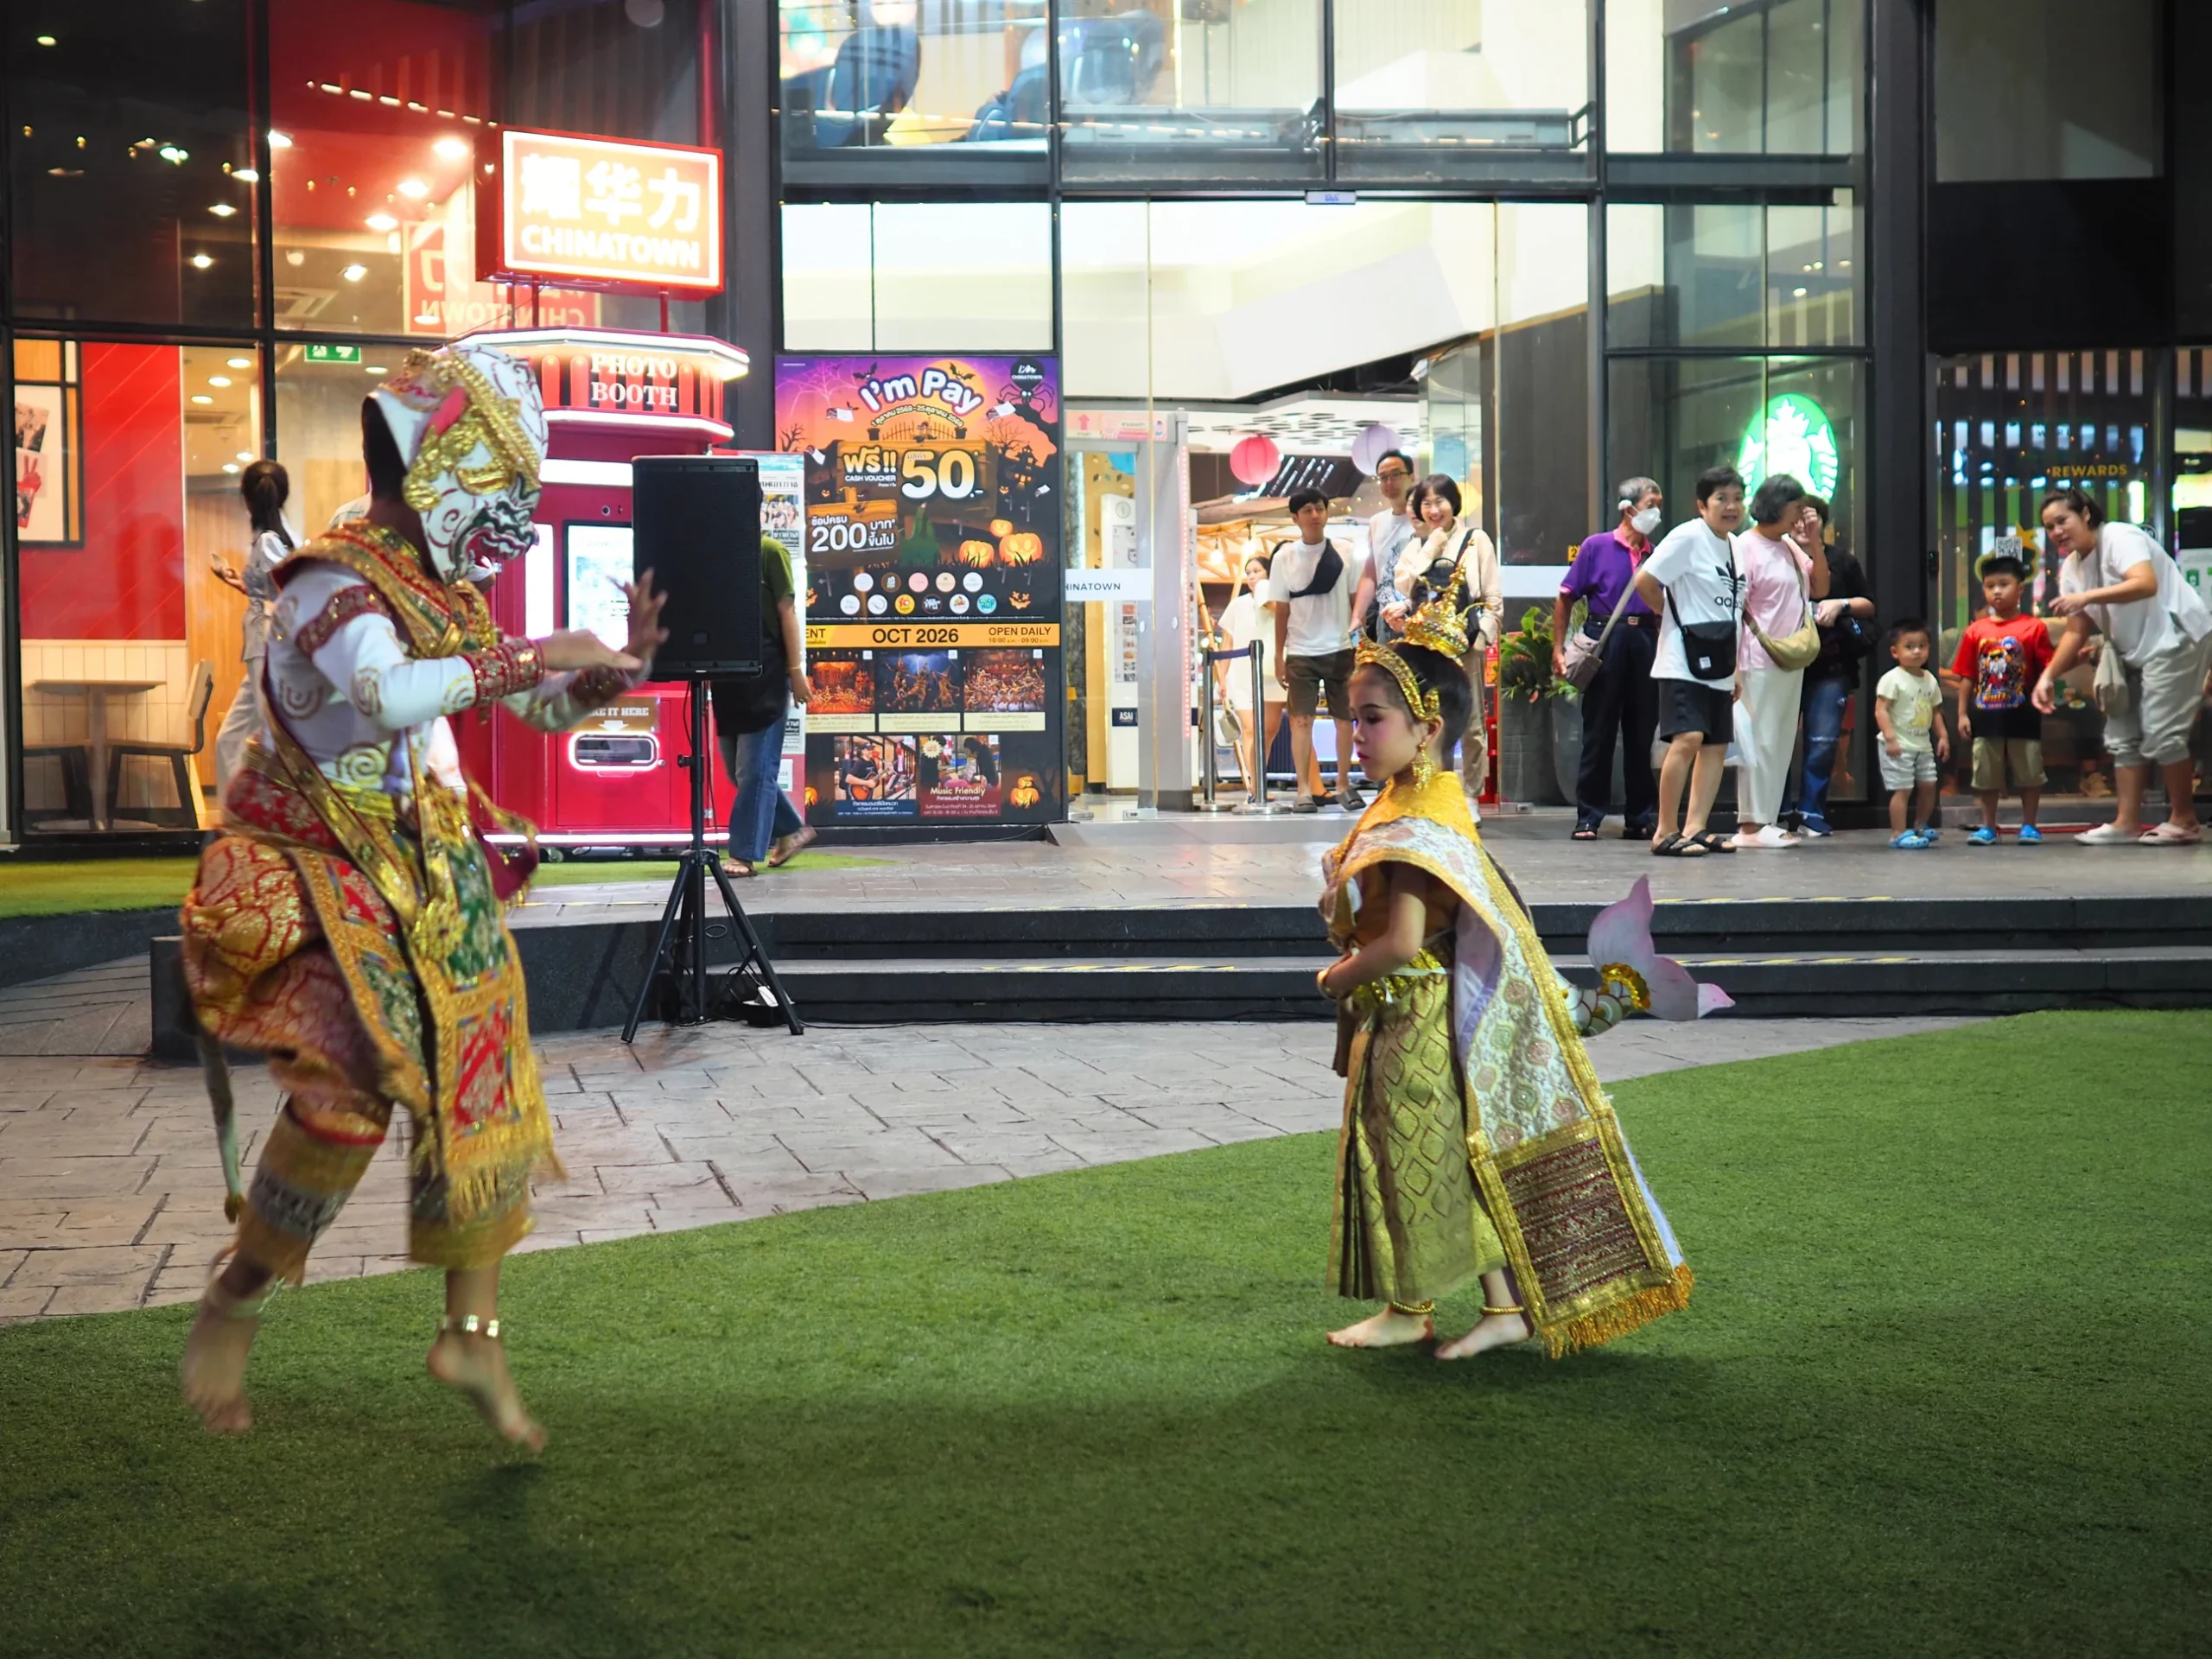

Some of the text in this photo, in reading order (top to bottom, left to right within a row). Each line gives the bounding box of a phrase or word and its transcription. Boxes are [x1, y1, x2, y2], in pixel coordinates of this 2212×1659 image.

[520, 224, 701, 269] CHINATOWN
[590, 353, 677, 378] PHOTO
[591, 381, 677, 406] BOOTH
[859, 370, 982, 414] I'm Pay
[2051, 464, 2127, 478] REWARDS
[811, 522, 867, 552] 200
[1065, 582, 1121, 591] HINATOWN
[806, 628, 826, 639] ENT
[872, 628, 959, 643] OCT 2026
[988, 627, 1052, 636] OPEN DAILY
[588, 707, 650, 716] KE IT HERE
[1119, 711, 1134, 721] ASAI
[955, 785, 986, 797] Friendly
